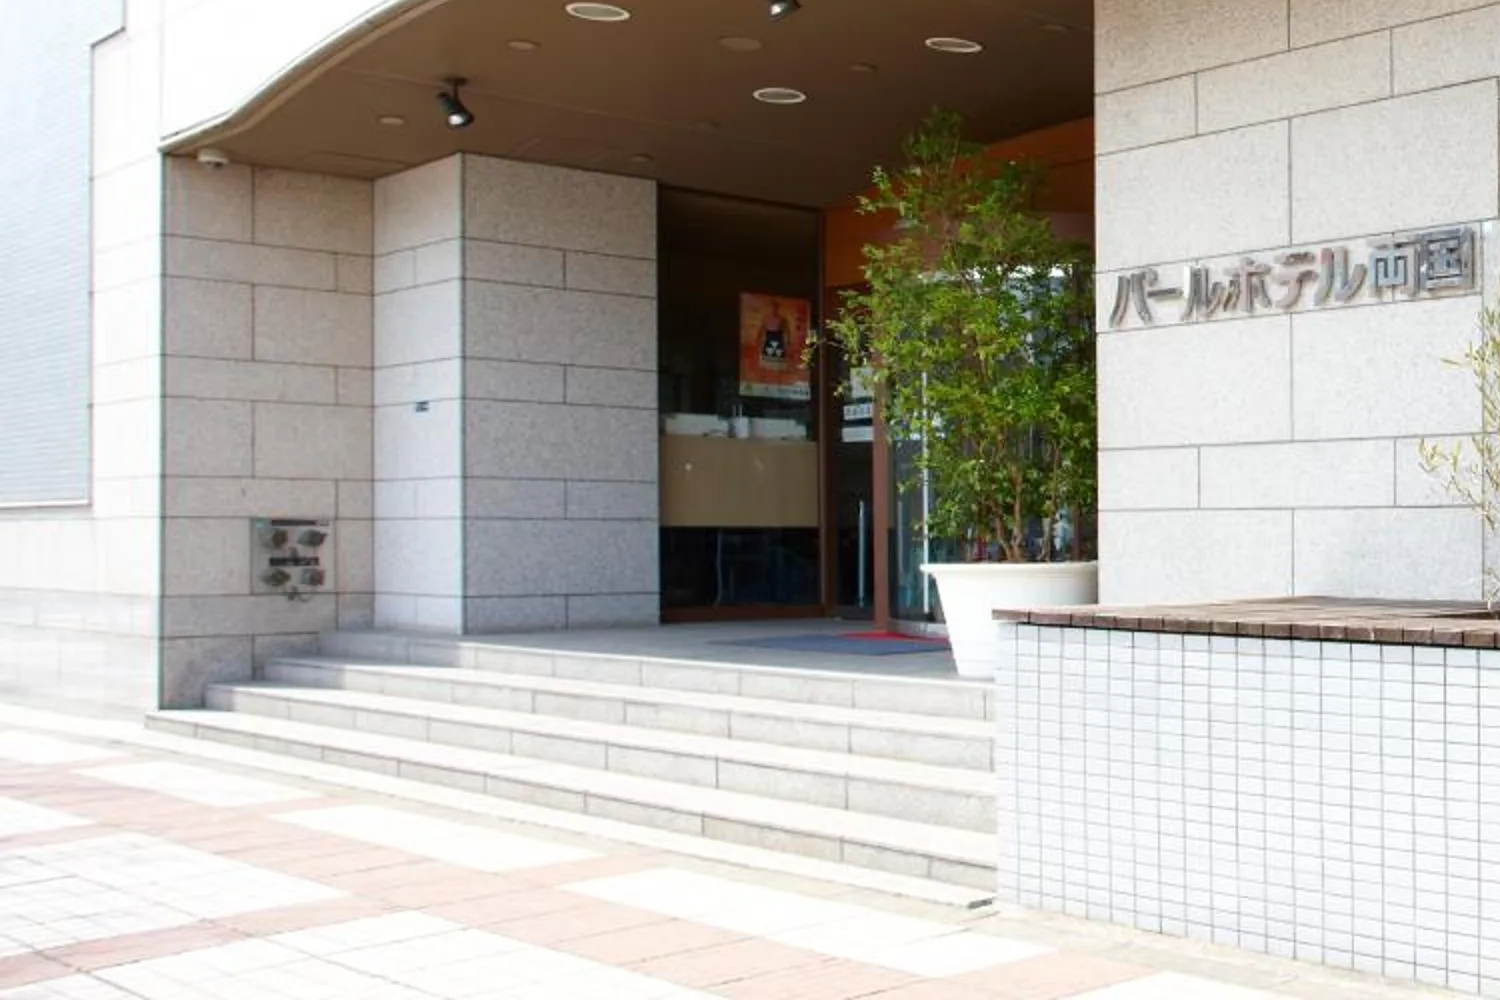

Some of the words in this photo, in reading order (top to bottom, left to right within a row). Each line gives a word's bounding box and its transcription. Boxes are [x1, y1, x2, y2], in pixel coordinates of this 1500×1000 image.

[1109, 227, 1476, 327] パールホテル両国
